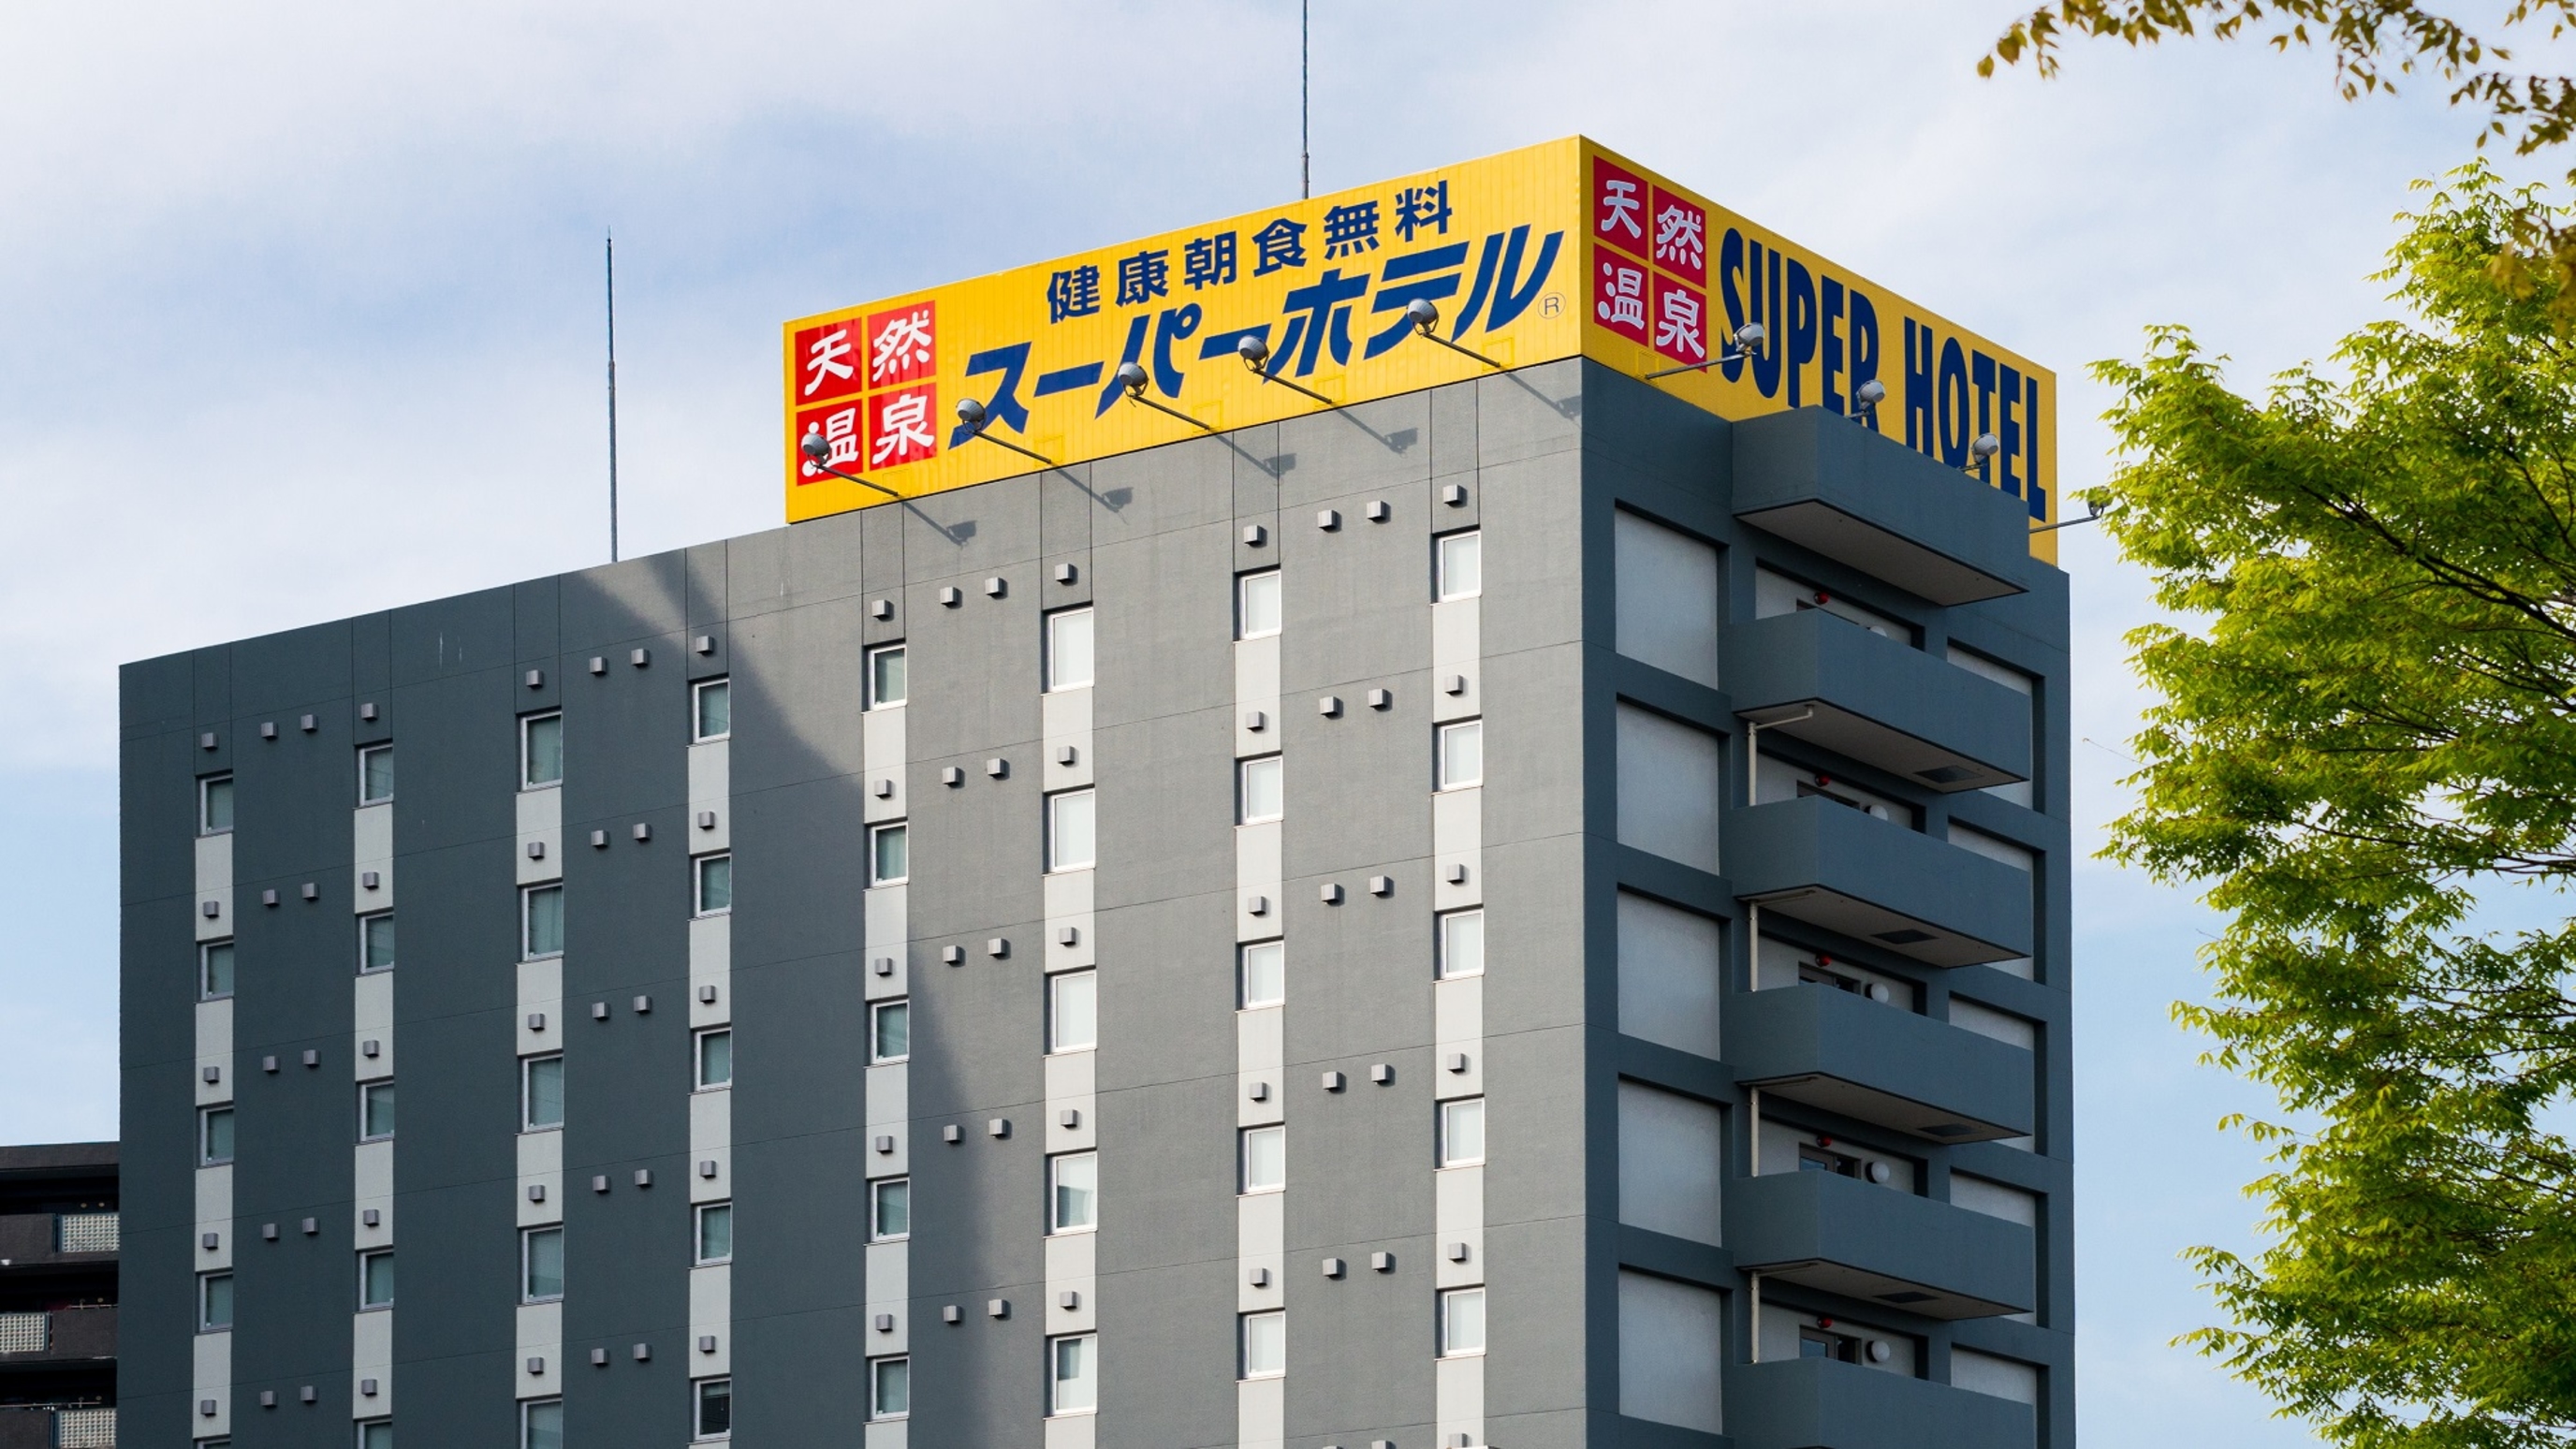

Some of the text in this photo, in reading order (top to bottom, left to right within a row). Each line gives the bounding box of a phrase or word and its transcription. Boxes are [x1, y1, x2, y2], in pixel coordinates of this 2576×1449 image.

[1047, 180, 1453, 324] 健康朝食無料
[1600, 180, 1703, 270] 天然
[804, 309, 932, 396] 天然
[1598, 262, 1705, 359] 温泉
[1720, 227, 2046, 522] SUPER HOTEL
[801, 393, 935, 477] 温泉
